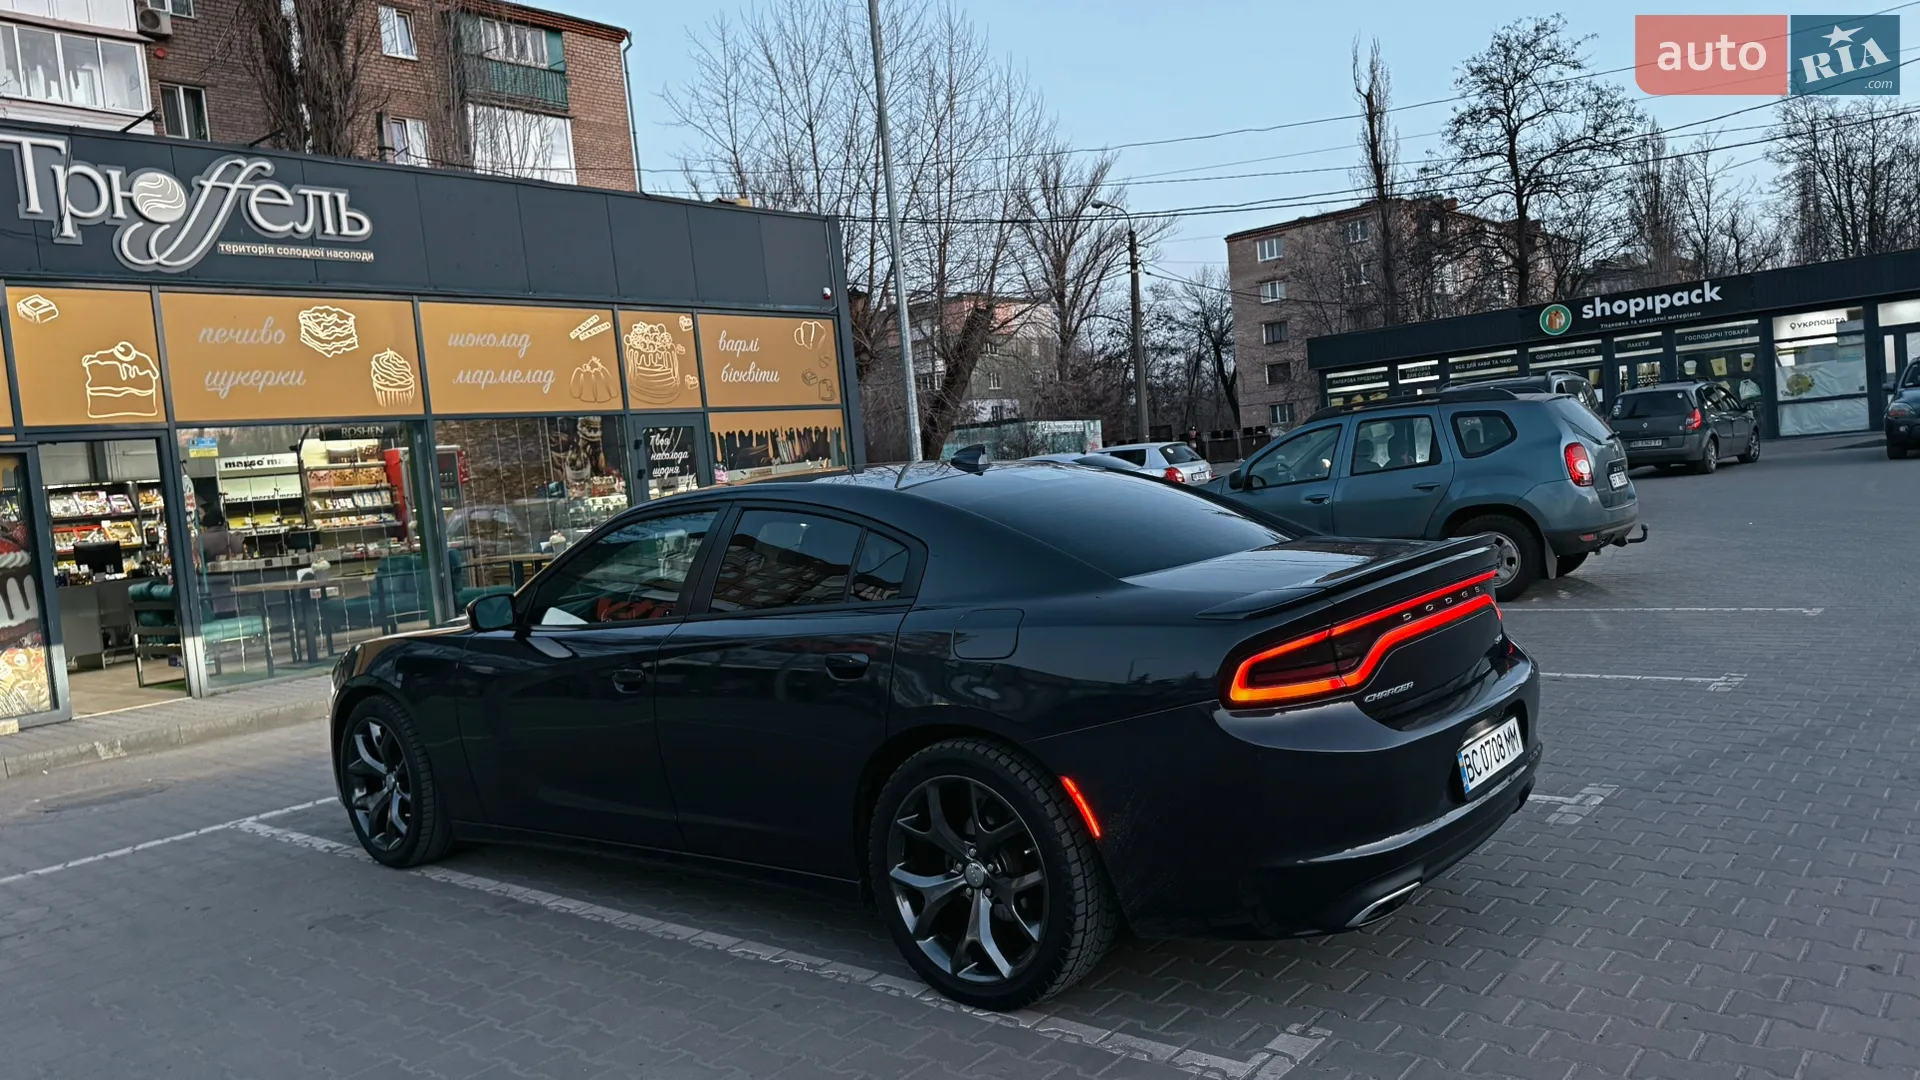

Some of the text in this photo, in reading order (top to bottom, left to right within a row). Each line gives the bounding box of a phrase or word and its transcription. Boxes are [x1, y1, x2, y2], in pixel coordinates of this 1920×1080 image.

[219, 243, 375, 262] територія солодкої насолоди
[198, 316, 286, 344] печиво
[1600, 321, 1629, 329] Упаковка
[1638, 316, 1667, 324] витратні
[1667, 312, 1701, 321] матеріали
[1797, 317, 1846, 329] УКРПОШТА
[718, 330, 760, 357] вафлі
[1684, 328, 1750, 341] ГОСПОДАРЧІ ТОВАРИ
[448, 332, 532, 358] шоколад
[1535, 347, 1596, 360] ОДНОРАЗОВИЙ ПОСУД
[1627, 341, 1650, 349] ПАКЕТИ
[452, 369, 556, 394] мармелад
[721, 362, 780, 383] бісквіти
[205, 369, 307, 399] цукерки
[341, 426, 384, 437] ROSHEN
[651, 451, 690, 464] насолода
[652, 466, 680, 480] щодня
[1402, 586, 1481, 621] DODGE
[1364, 681, 1414, 702] CHARGER
